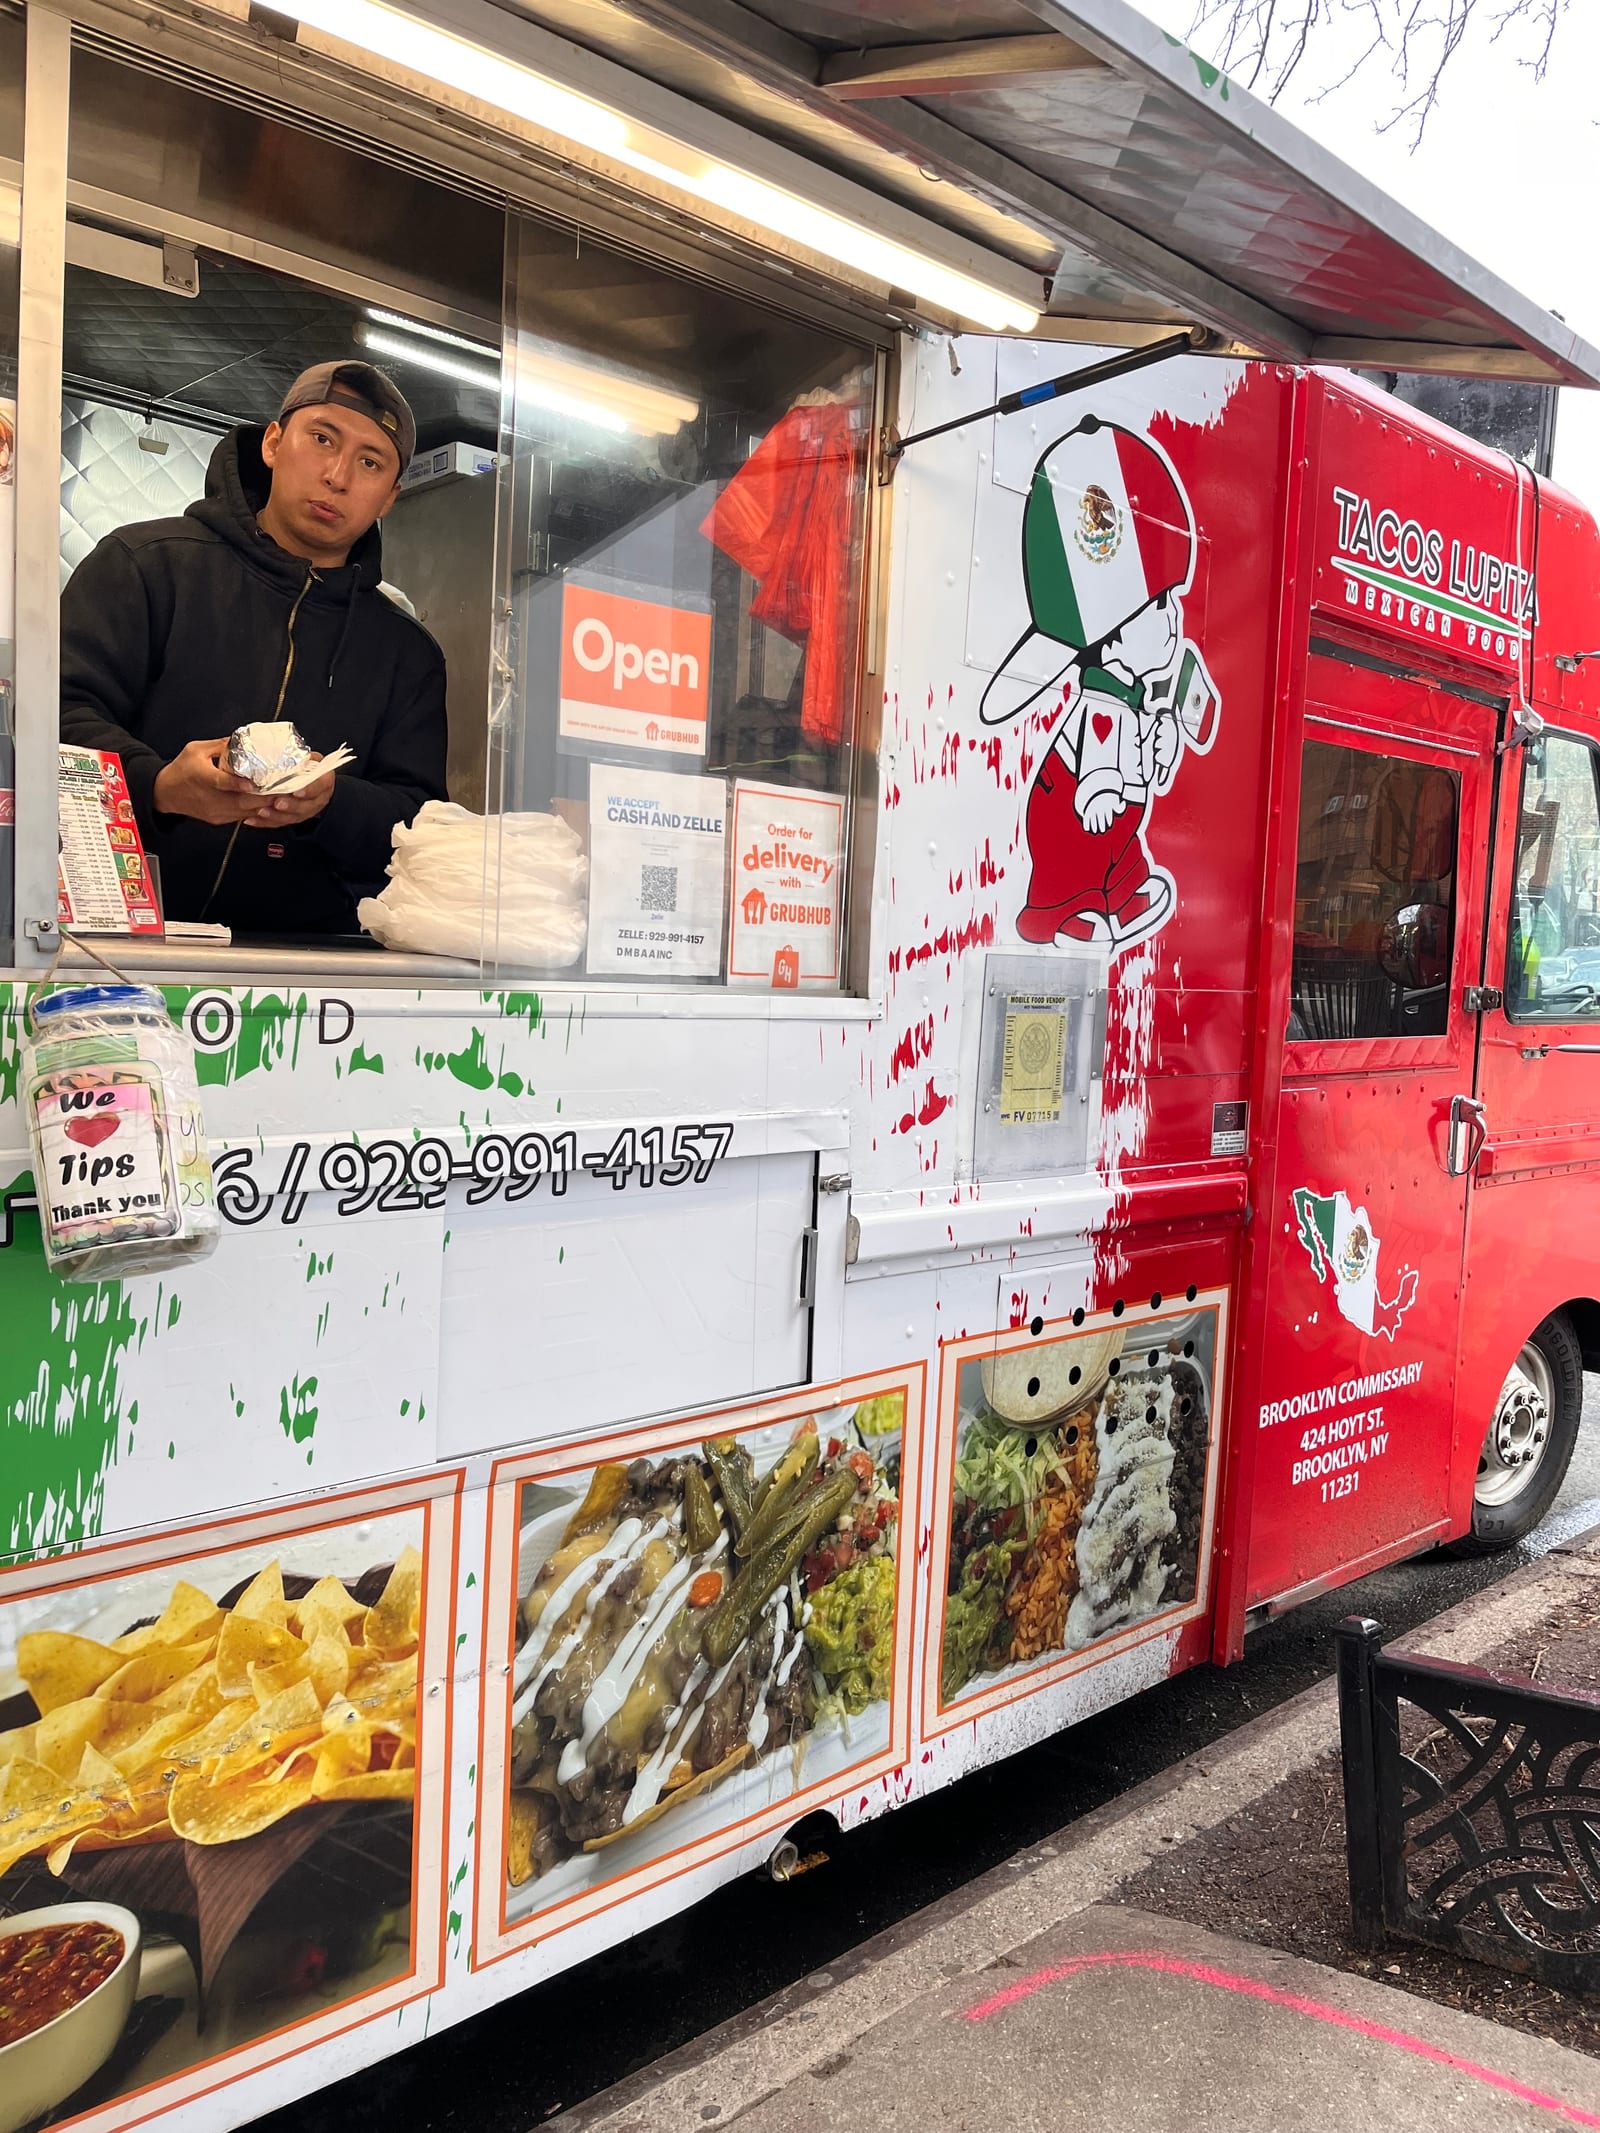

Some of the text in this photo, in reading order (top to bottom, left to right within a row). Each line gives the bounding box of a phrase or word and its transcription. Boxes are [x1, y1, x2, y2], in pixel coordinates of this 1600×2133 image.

[1333, 485, 1540, 626] TACOS LUPITA
[1345, 582, 1519, 661] MEXICAN FOOD
[572, 617, 698, 690] Open
[660, 730, 699, 744] GRUBHUB
[608, 796, 660, 810] WE ACCEPT
[607, 807, 722, 834] CASH AND ZELLE
[767, 823, 813, 840] Order for
[743, 842, 834, 884] delivery
[780, 876, 802, 889] with
[770, 902, 831, 926] GRUBHUB
[648, 931, 705, 944] 929-991-4157
[1010, 996, 1030, 1004] MOBILE
[1031, 996, 1045, 1004] FOOD
[59, 1091, 116, 1113] We
[1014, 1110, 1026, 1122] FV
[59, 1152, 135, 1186] Tips
[319, 1122, 734, 1217] 929-991-4157
[52, 1193, 161, 1223] Thank you
[1259, 1361, 1424, 1428] BROOKLYN COMMISSARY
[1300, 1406, 1385, 1452] 424 HOYT ST.
[1292, 1432, 1390, 1485] BROOKLYN, NY
[1321, 1471, 1359, 1503] 11231
